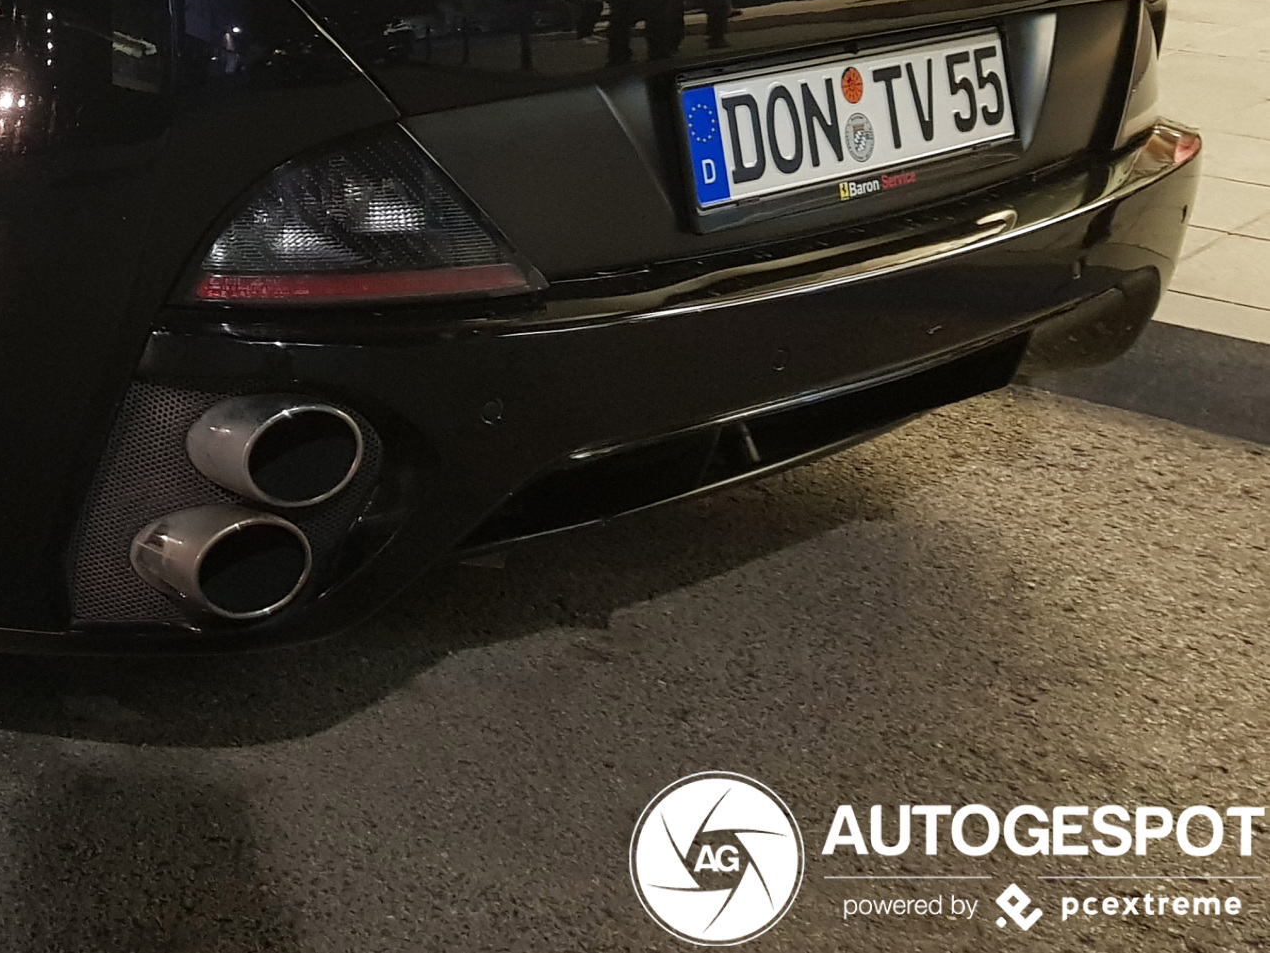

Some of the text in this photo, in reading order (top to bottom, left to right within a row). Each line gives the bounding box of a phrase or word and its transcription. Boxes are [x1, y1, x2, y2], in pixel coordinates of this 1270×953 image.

[722, 77, 844, 184] DON
[872, 58, 934, 149] TV
[945, 45, 1004, 133] 55
[701, 159, 716, 184] D
[849, 172, 916, 197] Baron Service
